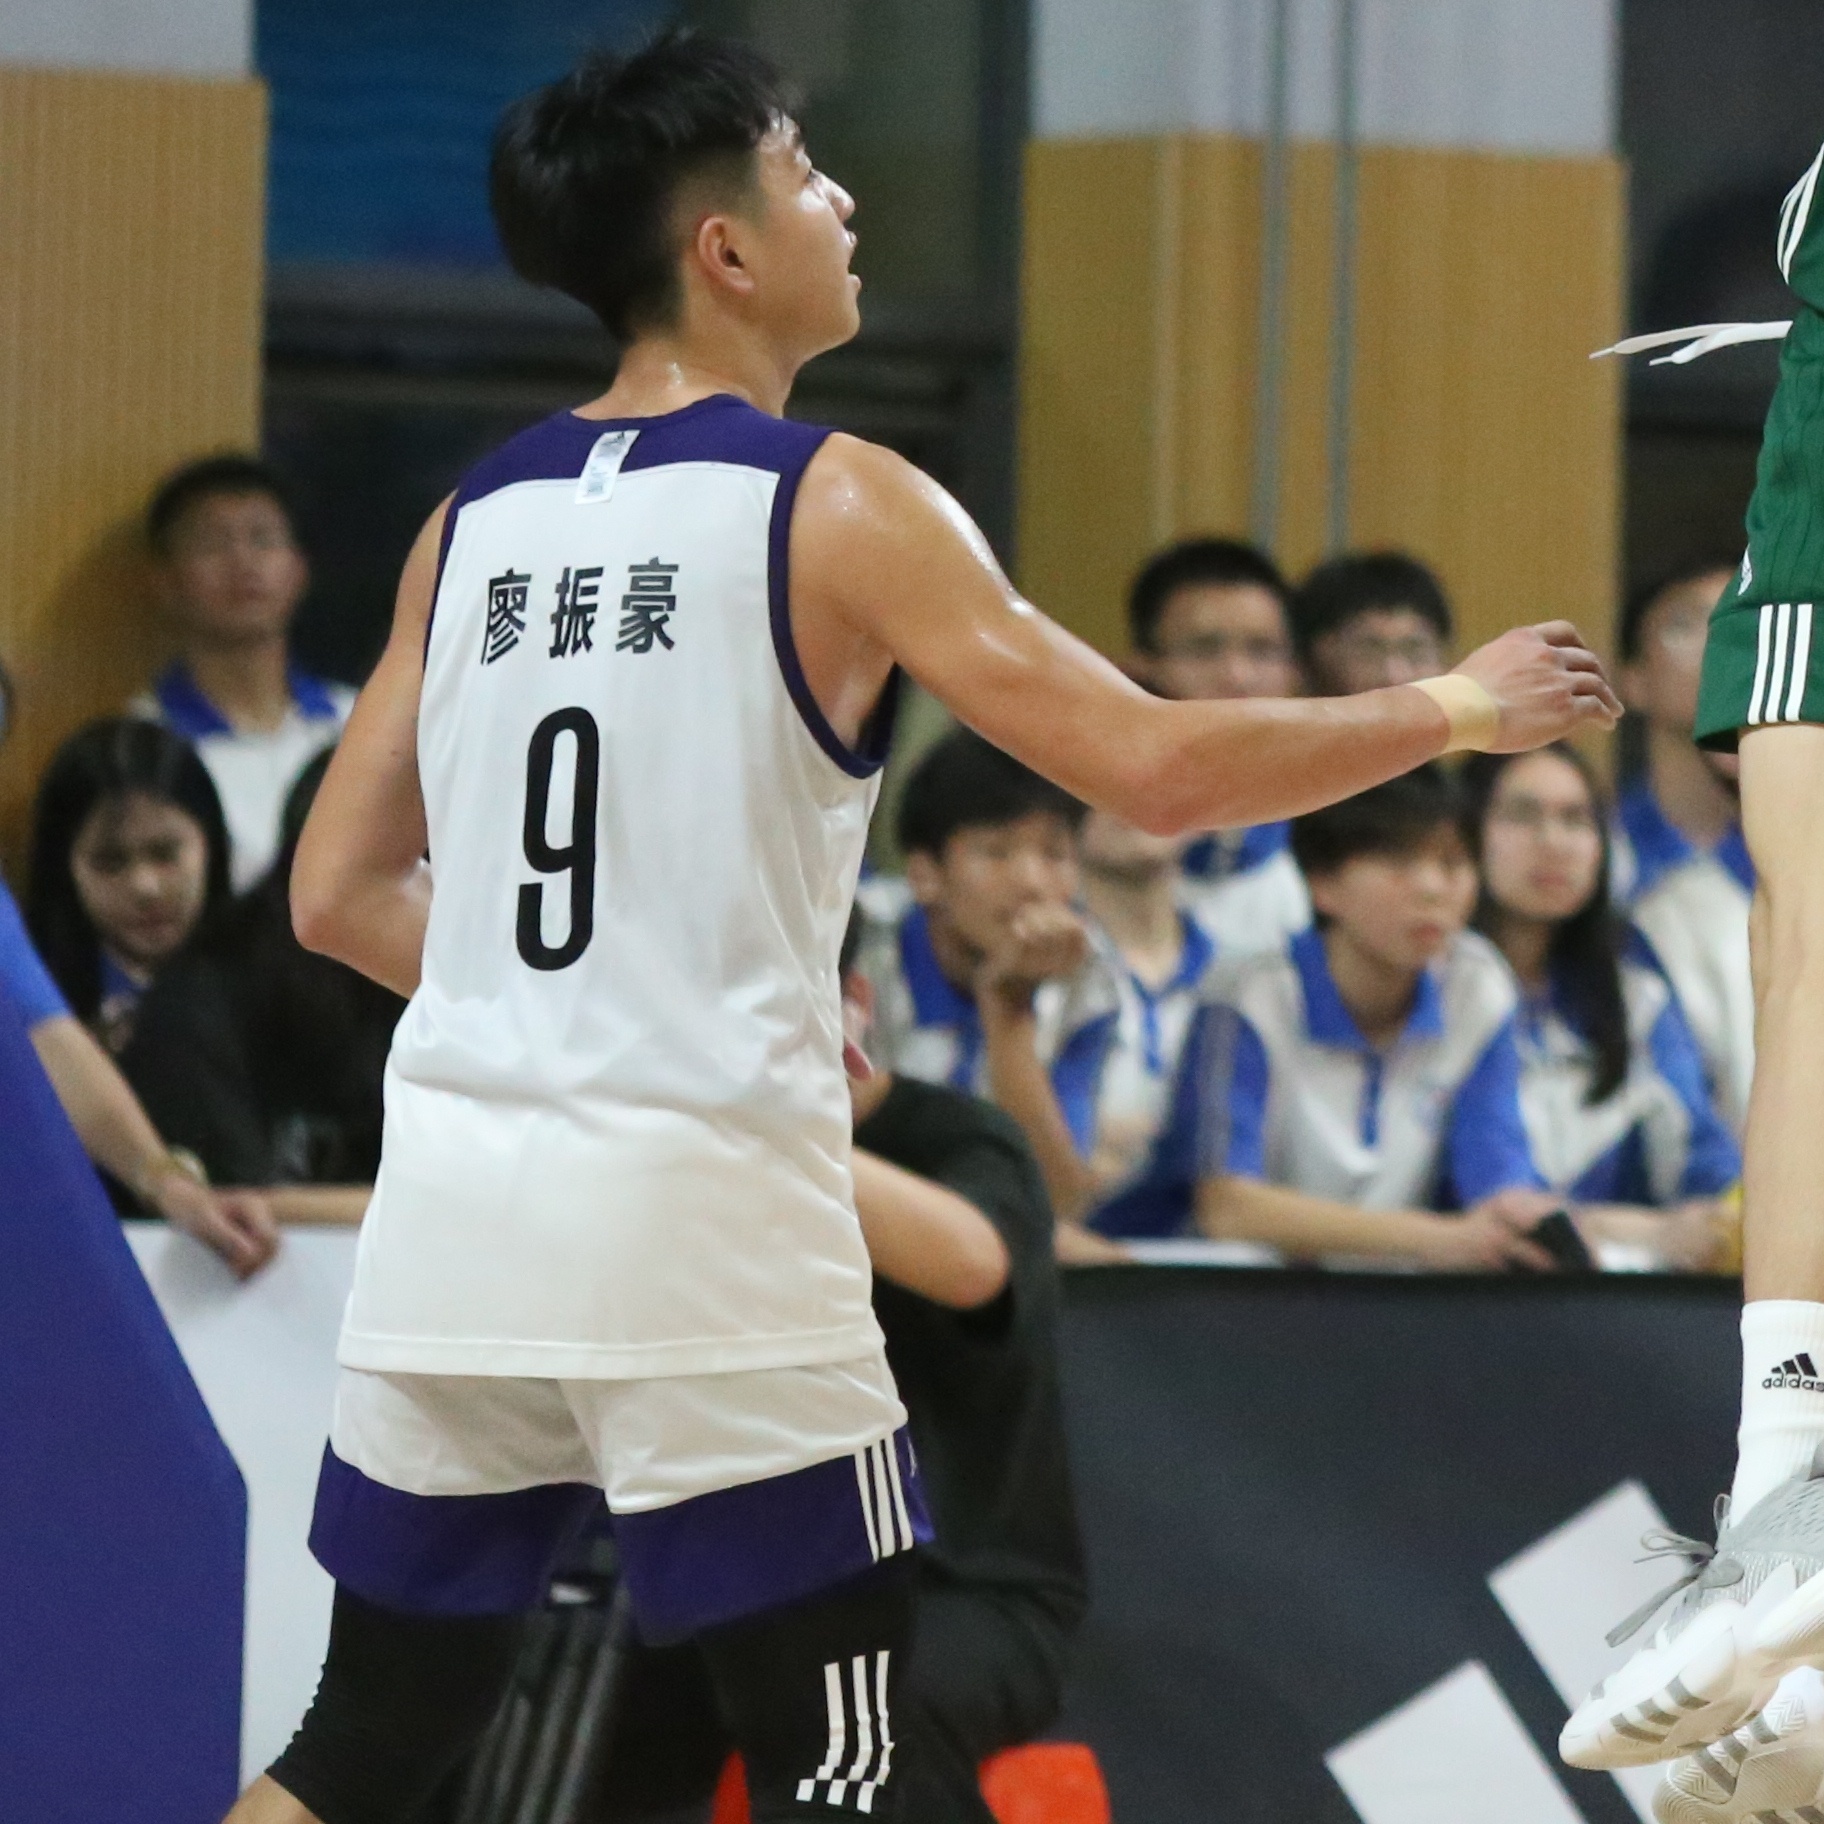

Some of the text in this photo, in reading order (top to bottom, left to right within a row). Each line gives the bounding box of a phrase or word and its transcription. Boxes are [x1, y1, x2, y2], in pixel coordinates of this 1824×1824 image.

[480, 556, 680, 666] 廖振豪
[516, 706, 600, 971] 9
